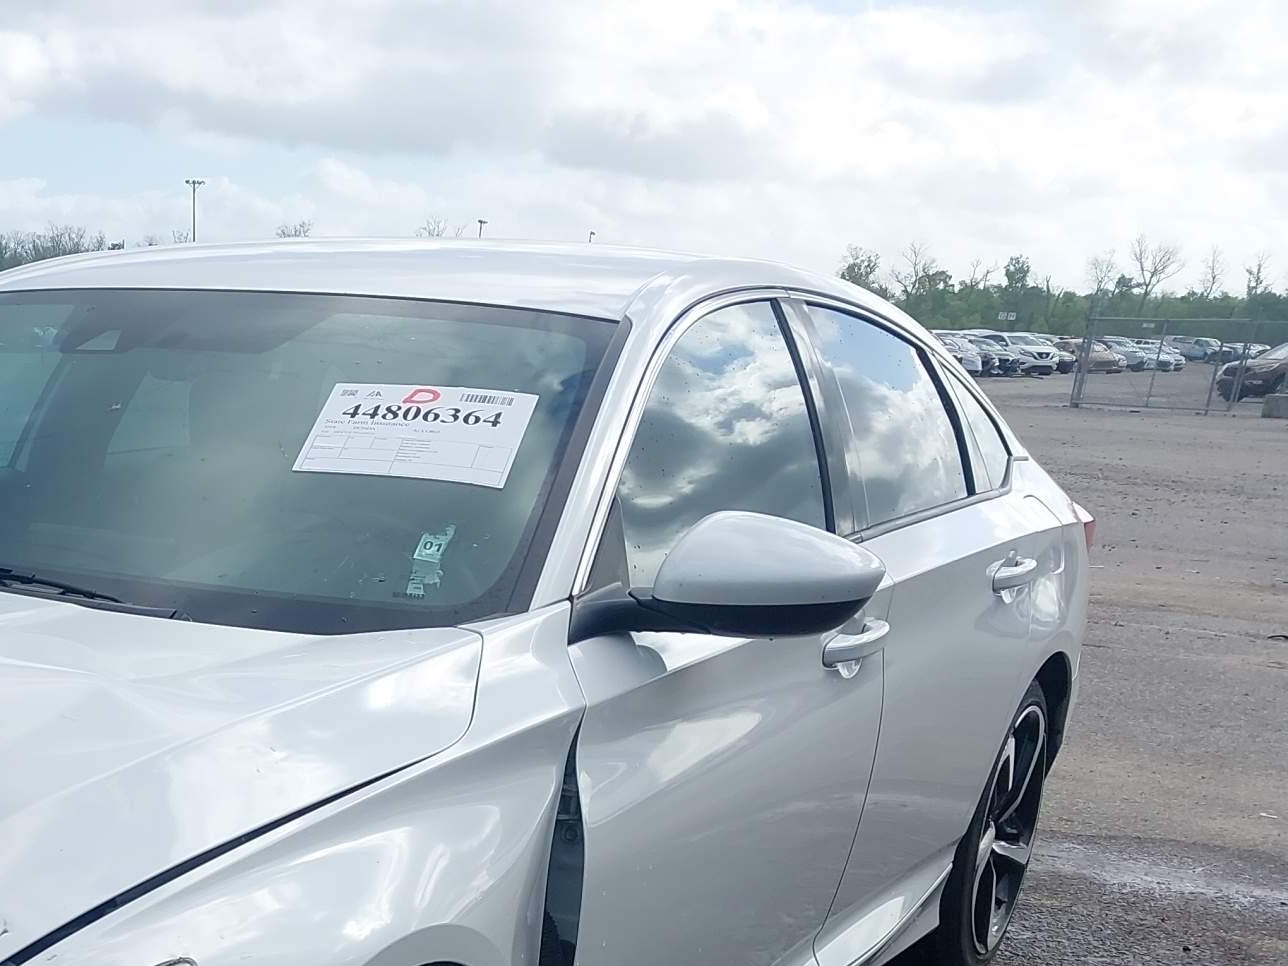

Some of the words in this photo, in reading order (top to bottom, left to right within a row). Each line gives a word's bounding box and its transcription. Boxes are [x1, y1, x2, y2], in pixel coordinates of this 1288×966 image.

[403, 388, 441, 404] D
[342, 403, 504, 428] 44806364
[423, 541, 443, 552] 01
